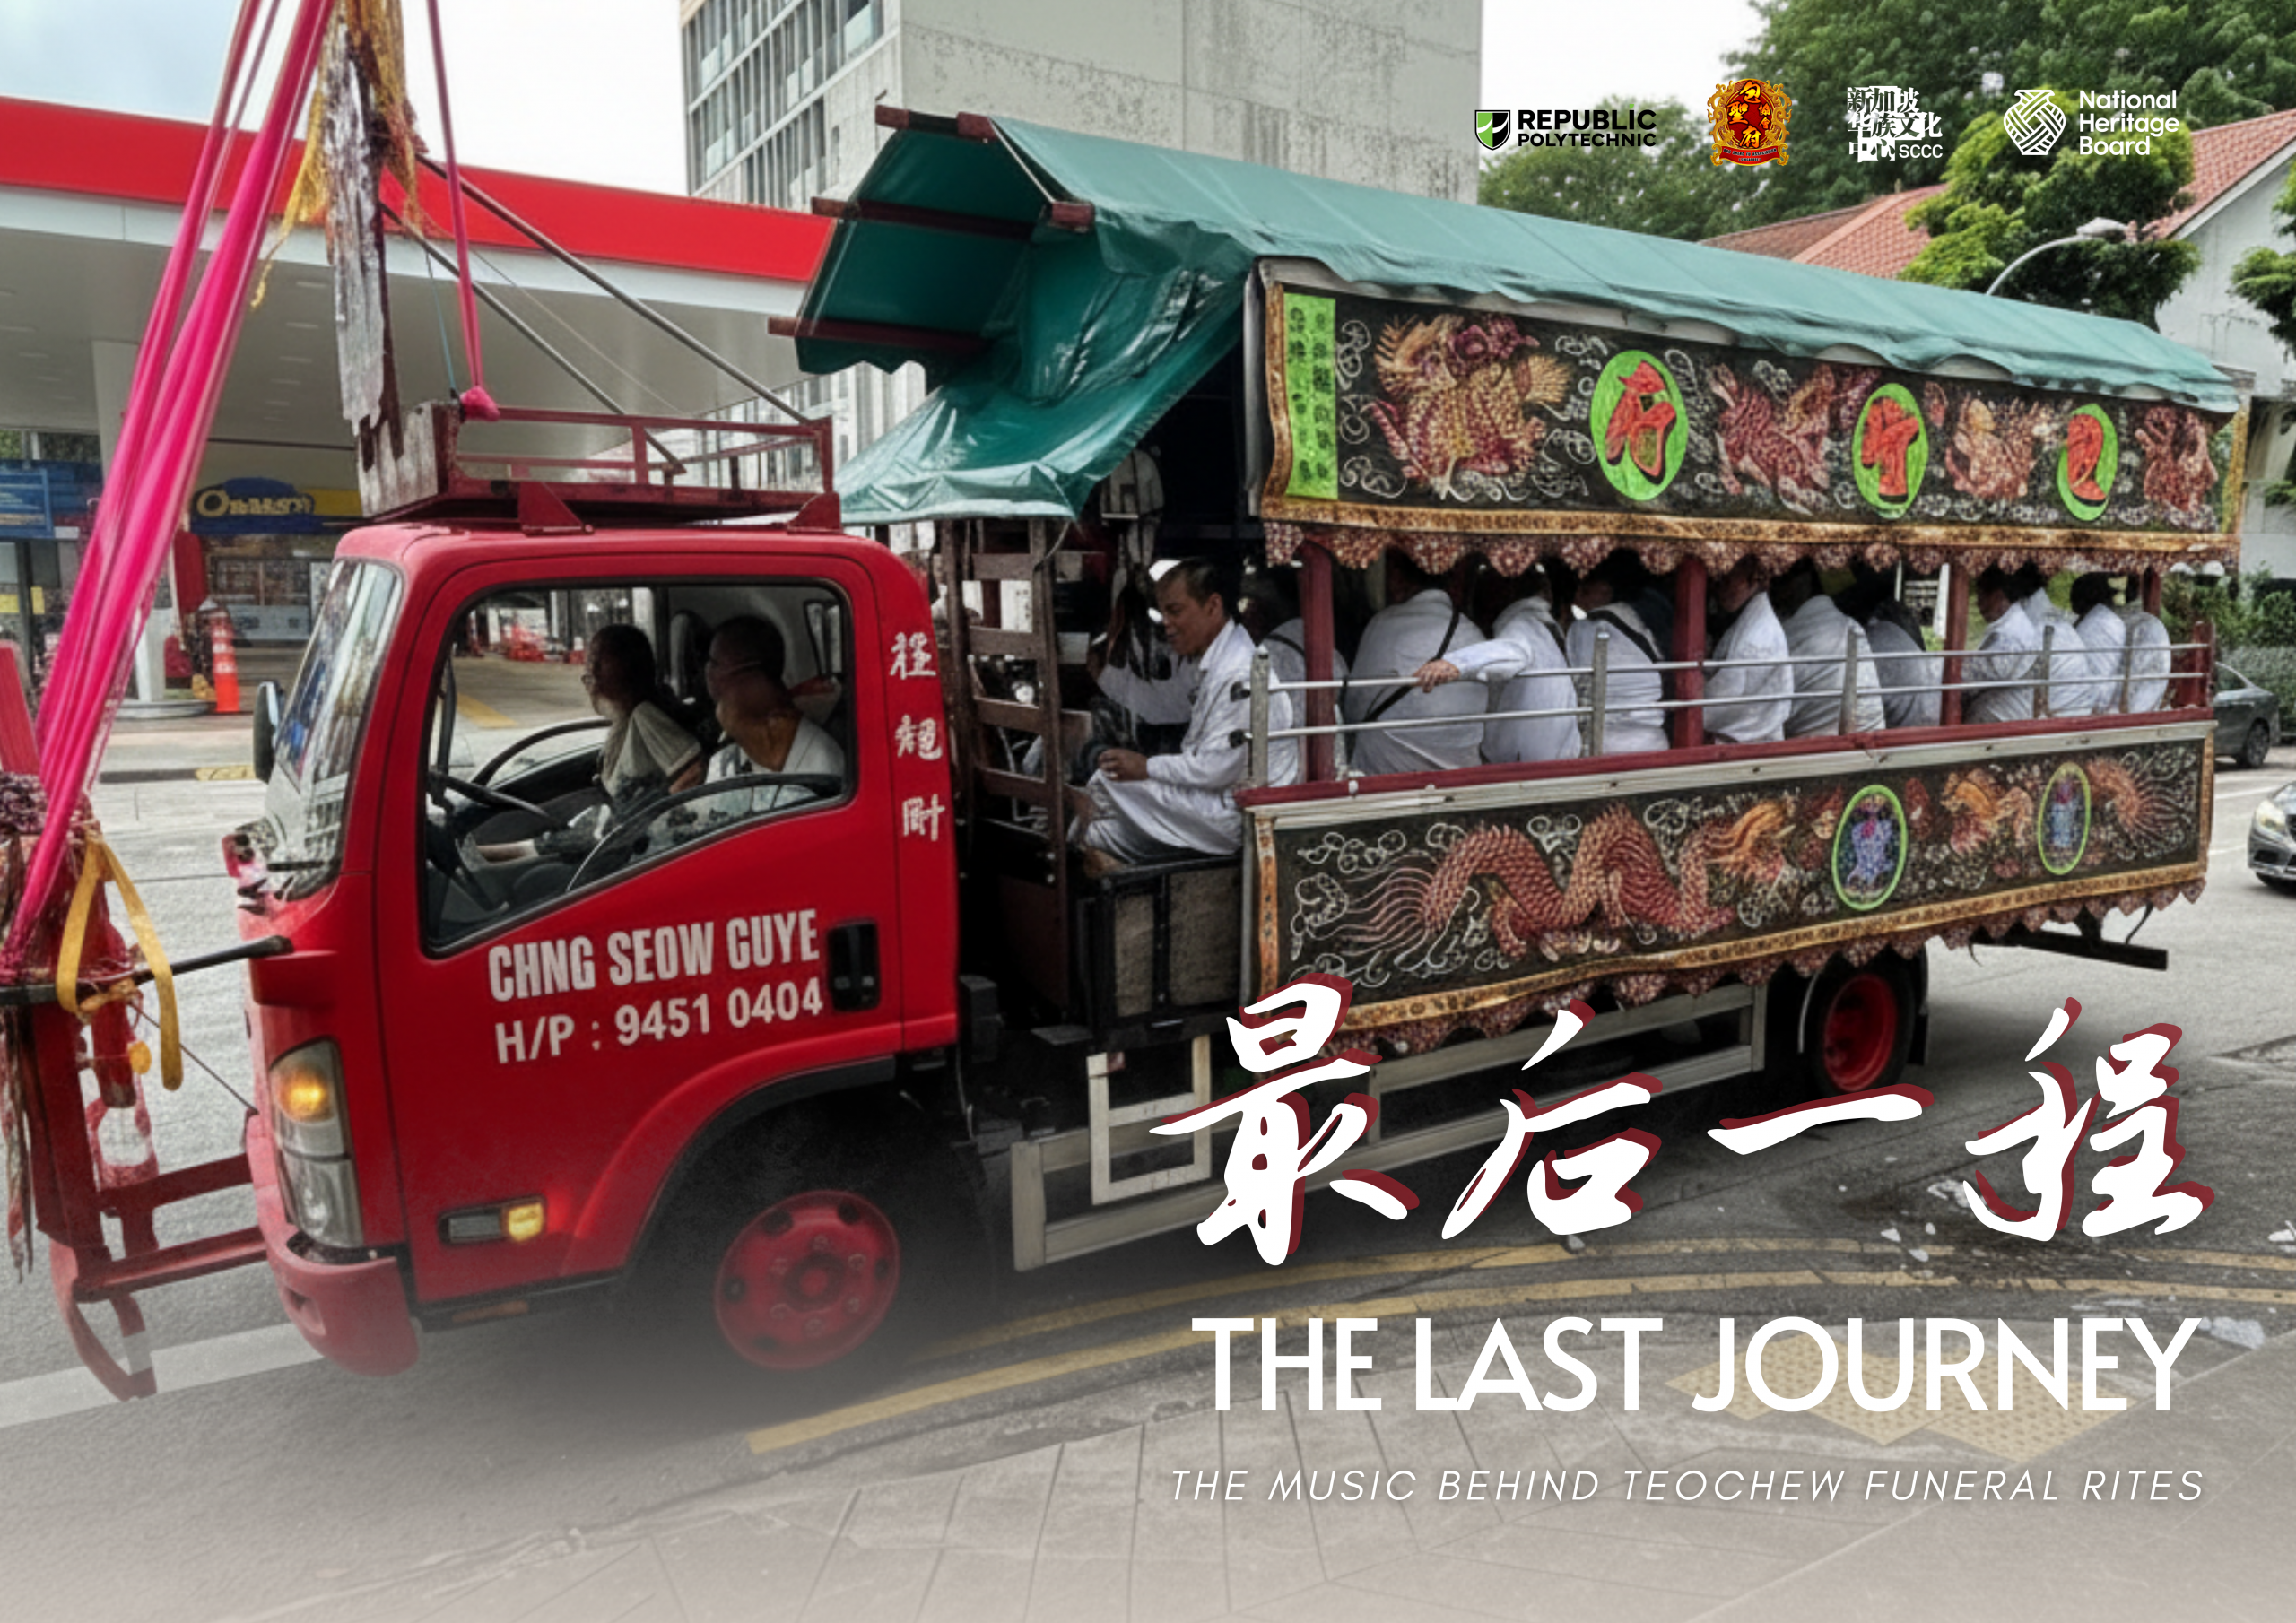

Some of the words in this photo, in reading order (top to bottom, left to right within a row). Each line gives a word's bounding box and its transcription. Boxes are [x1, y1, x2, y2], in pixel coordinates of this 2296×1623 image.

[489, 936, 596, 1002] CHNG
[607, 922, 714, 985] SEOW
[726, 909, 820, 970] GUYE
[495, 1015, 575, 1064] H/P
[614, 994, 710, 1046] 9451
[727, 977, 822, 1028] 0404
